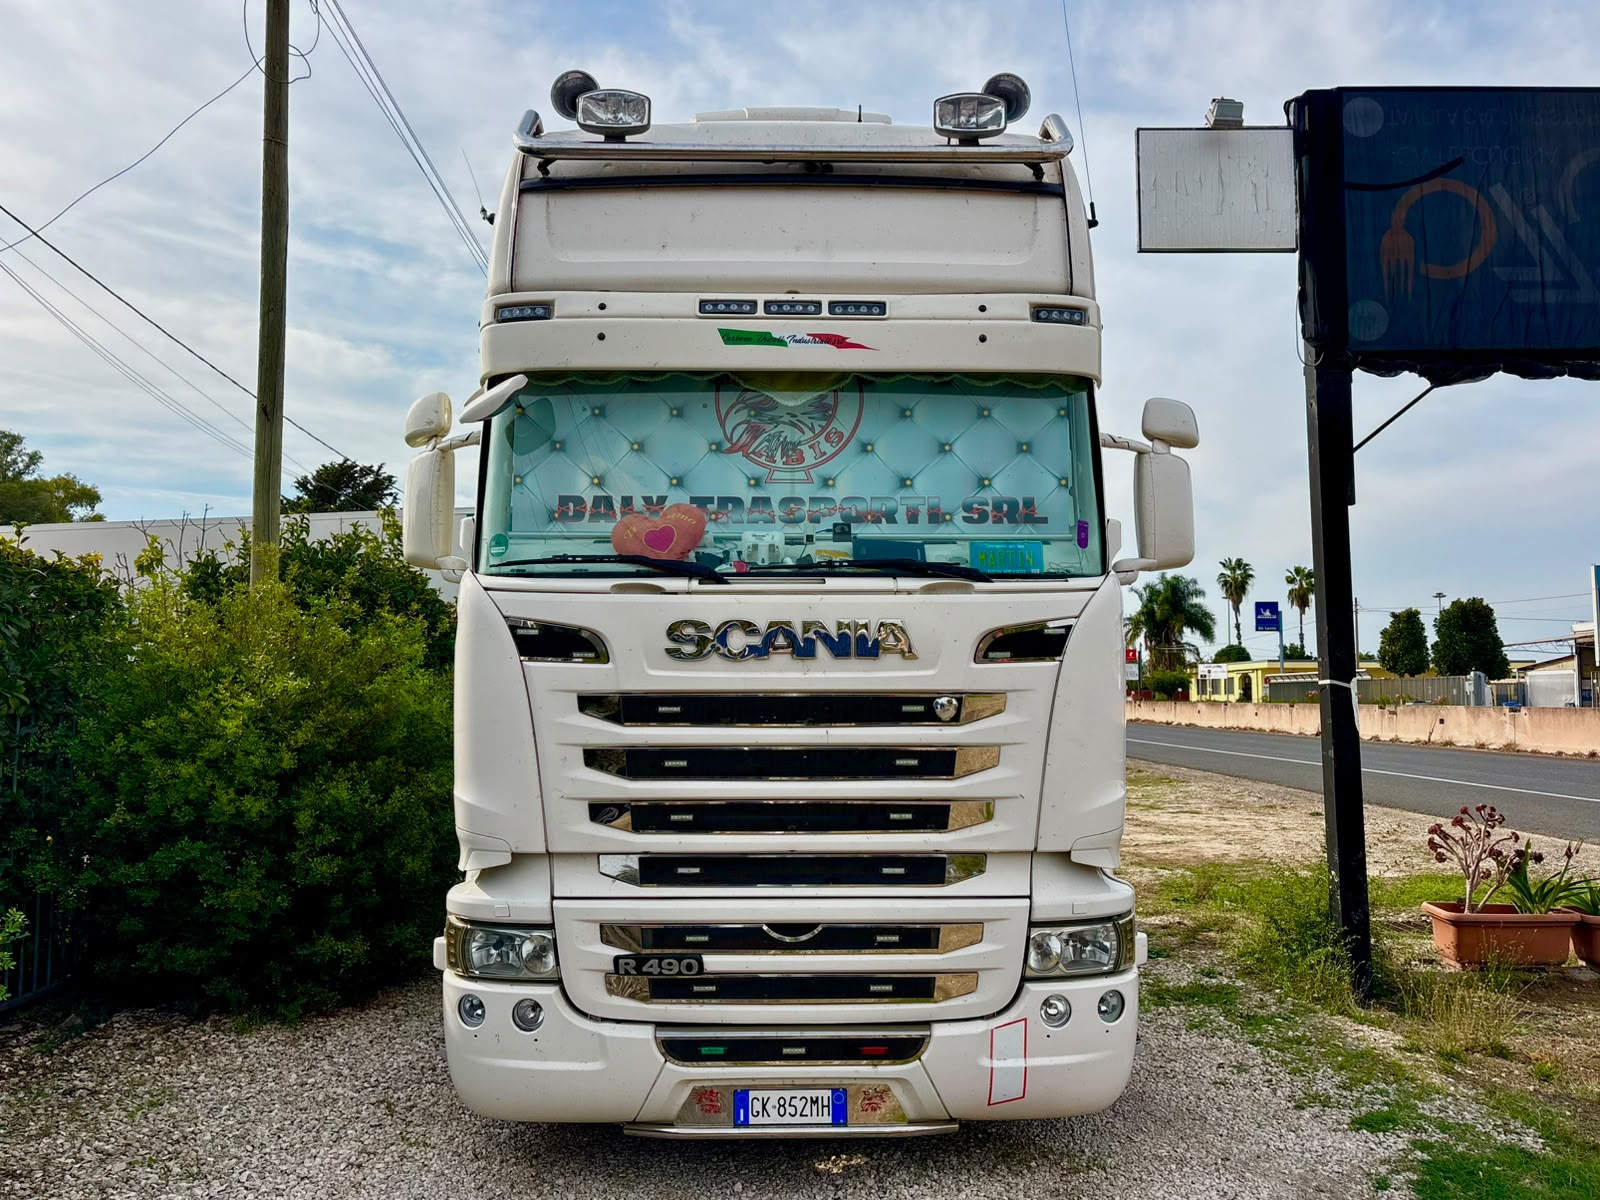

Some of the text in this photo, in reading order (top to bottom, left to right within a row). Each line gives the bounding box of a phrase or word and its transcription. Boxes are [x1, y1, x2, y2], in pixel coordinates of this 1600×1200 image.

[557, 494, 1049, 524] DALY TRASPORTI SRL
[978, 550, 1034, 569] MARTIN
[664, 618, 919, 662] SCANIA
[618, 958, 699, 975] R 490
